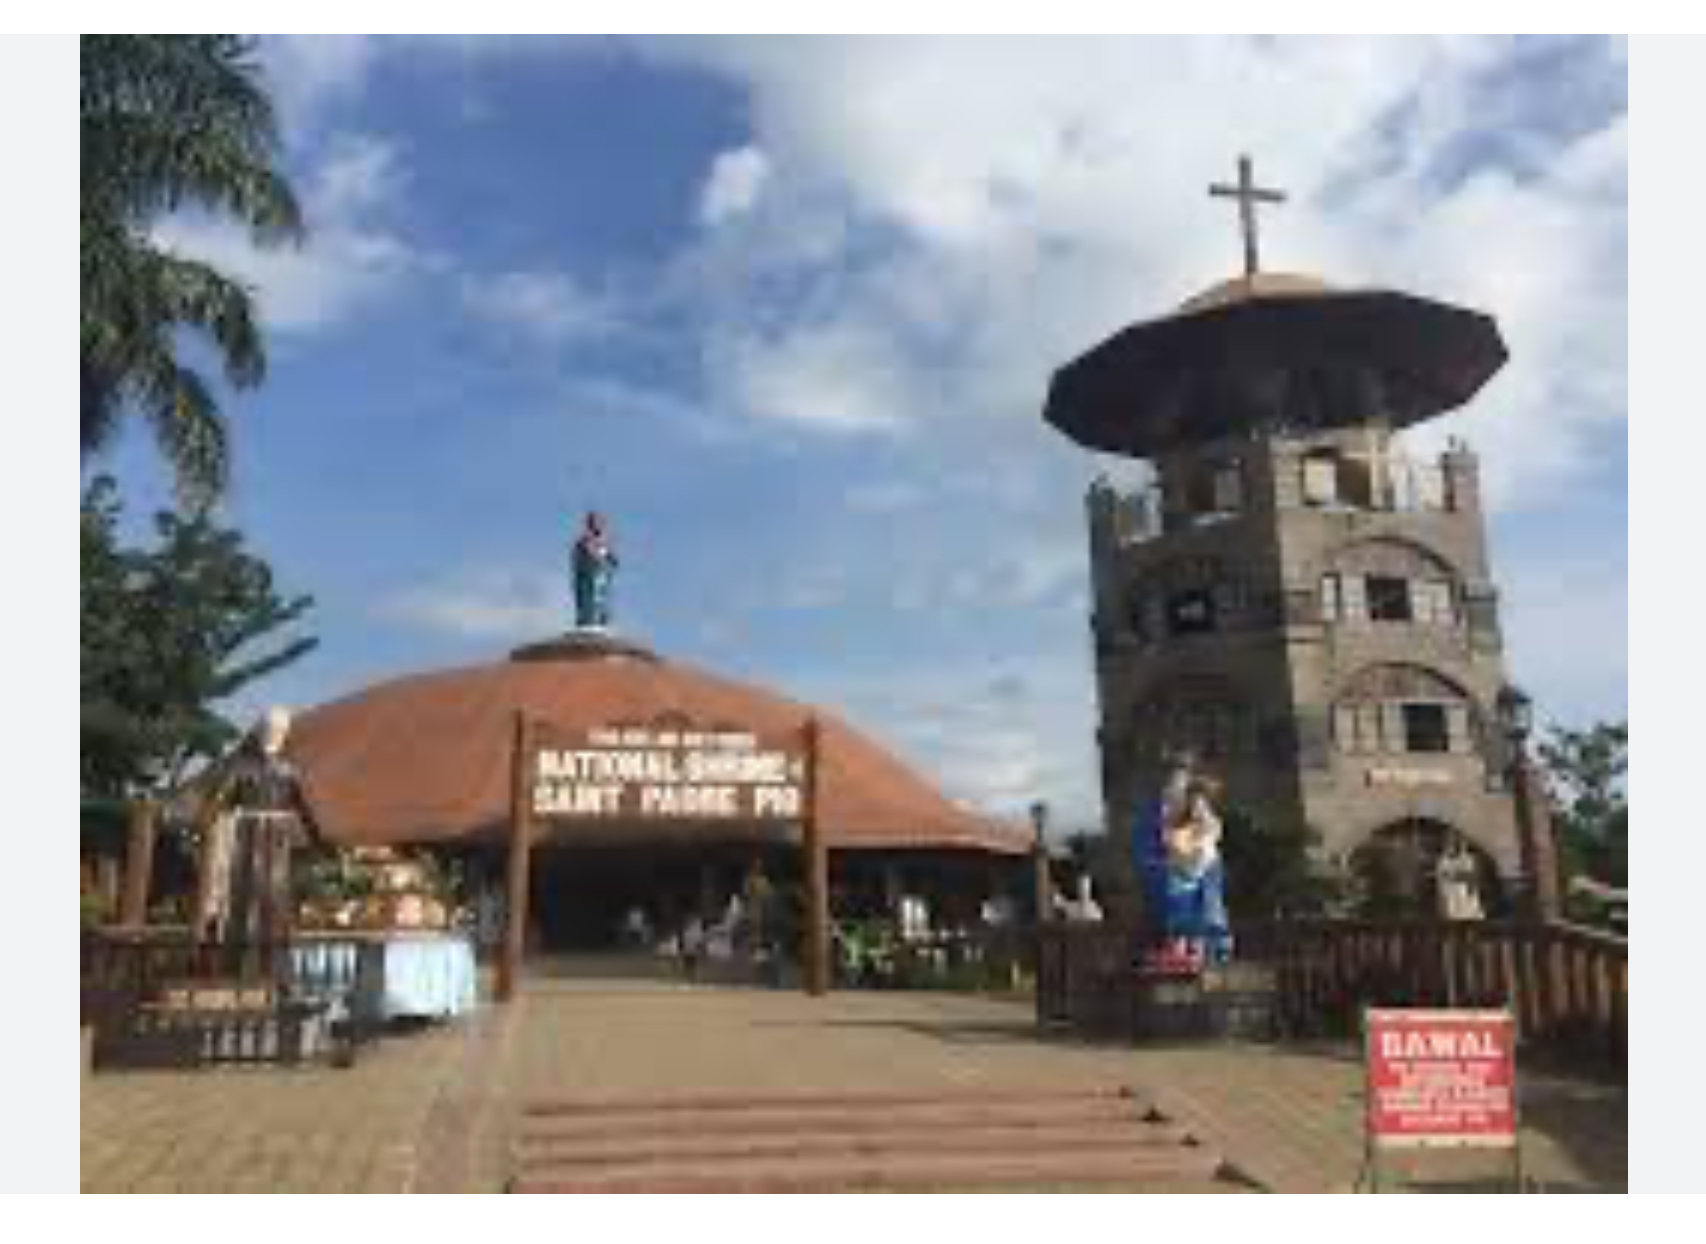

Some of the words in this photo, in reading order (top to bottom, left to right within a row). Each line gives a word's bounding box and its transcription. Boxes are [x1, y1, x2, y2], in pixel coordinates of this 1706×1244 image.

[538, 750, 679, 781] NATIONAL
[533, 785, 625, 815] SAINT
[641, 786, 738, 816] PADRE
[753, 786, 799, 816] PIO
[1382, 1032, 1503, 1059] BAWAL
